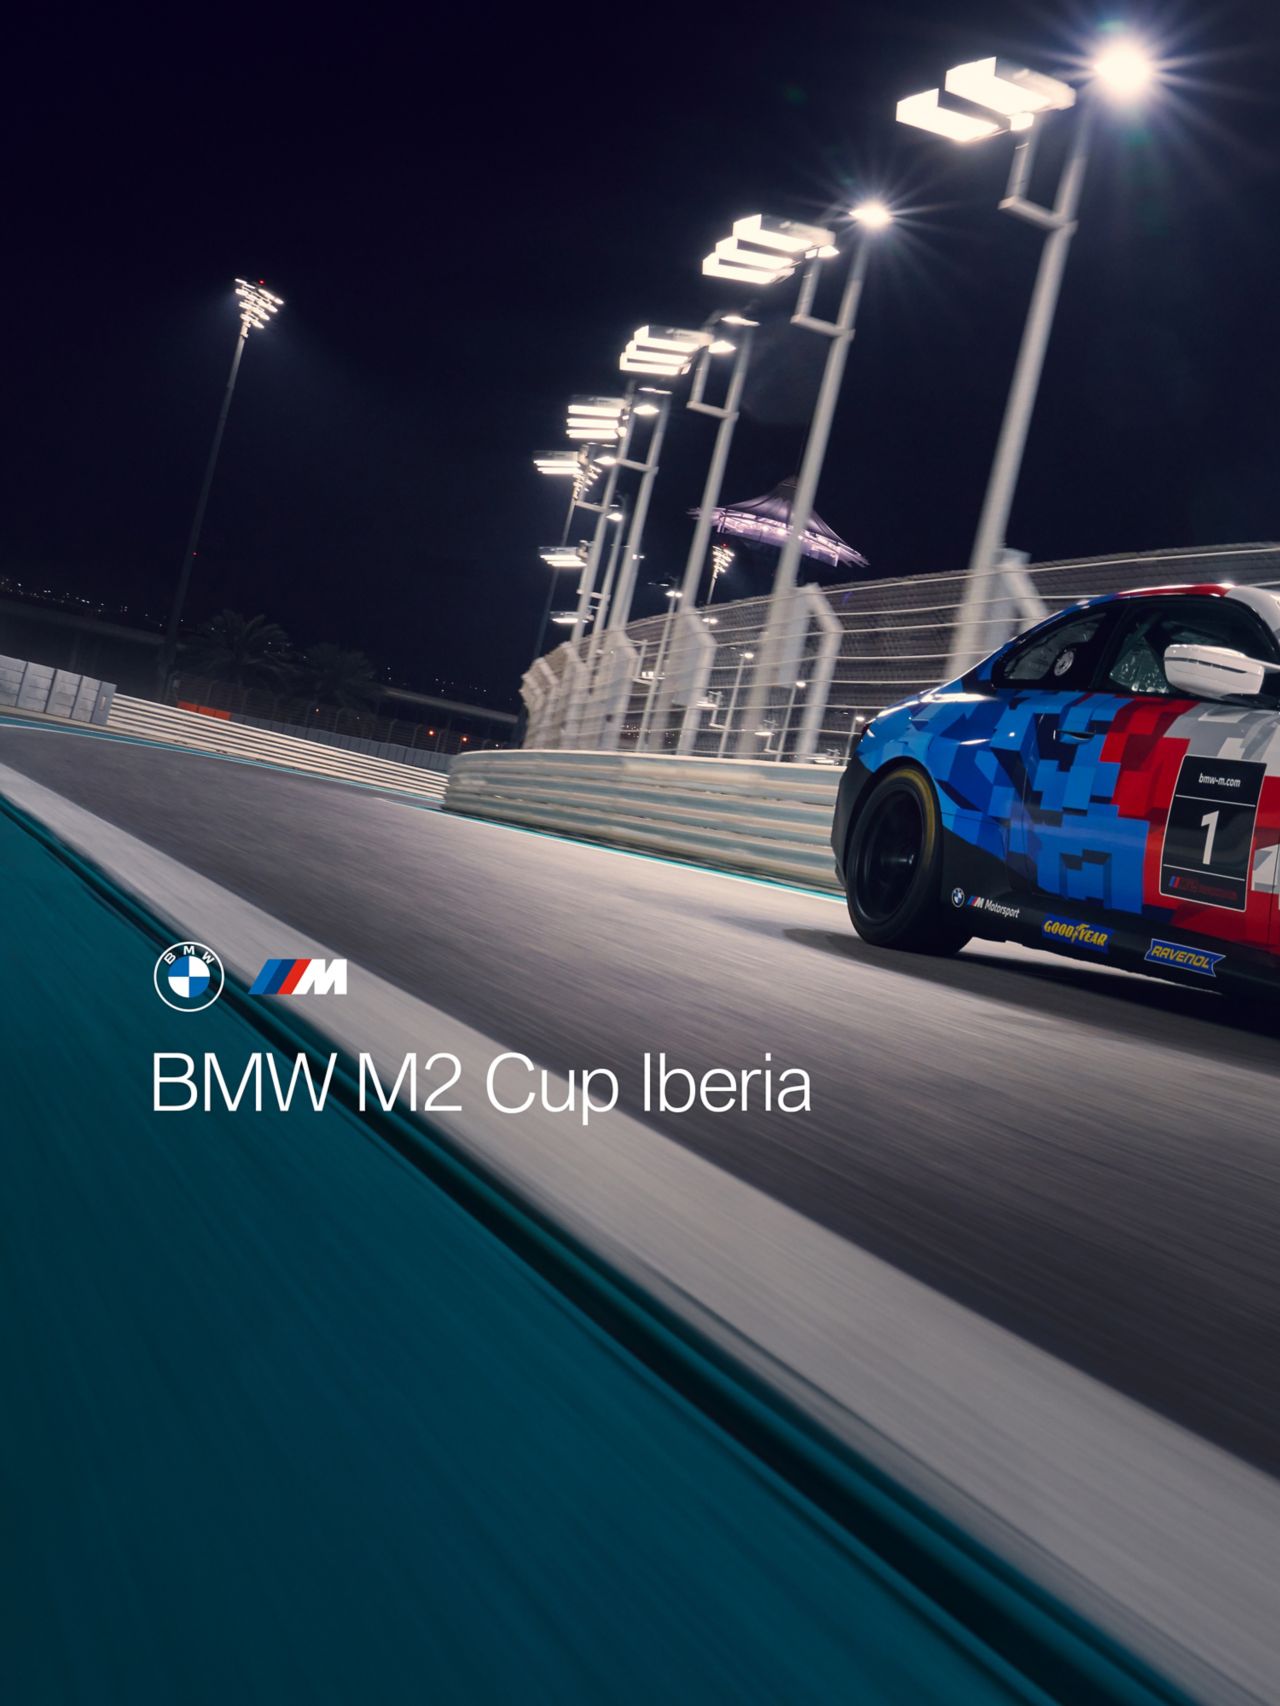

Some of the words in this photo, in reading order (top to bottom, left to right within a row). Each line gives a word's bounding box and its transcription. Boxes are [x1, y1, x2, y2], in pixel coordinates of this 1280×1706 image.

[1198, 772, 1242, 788] bmw-m.com
[1201, 810, 1219, 866] 1
[984, 898, 1020, 919] Motorsport
[1043, 919, 1109, 947] GOODYEAR
[1151, 945, 1211, 969] RAVENOL
